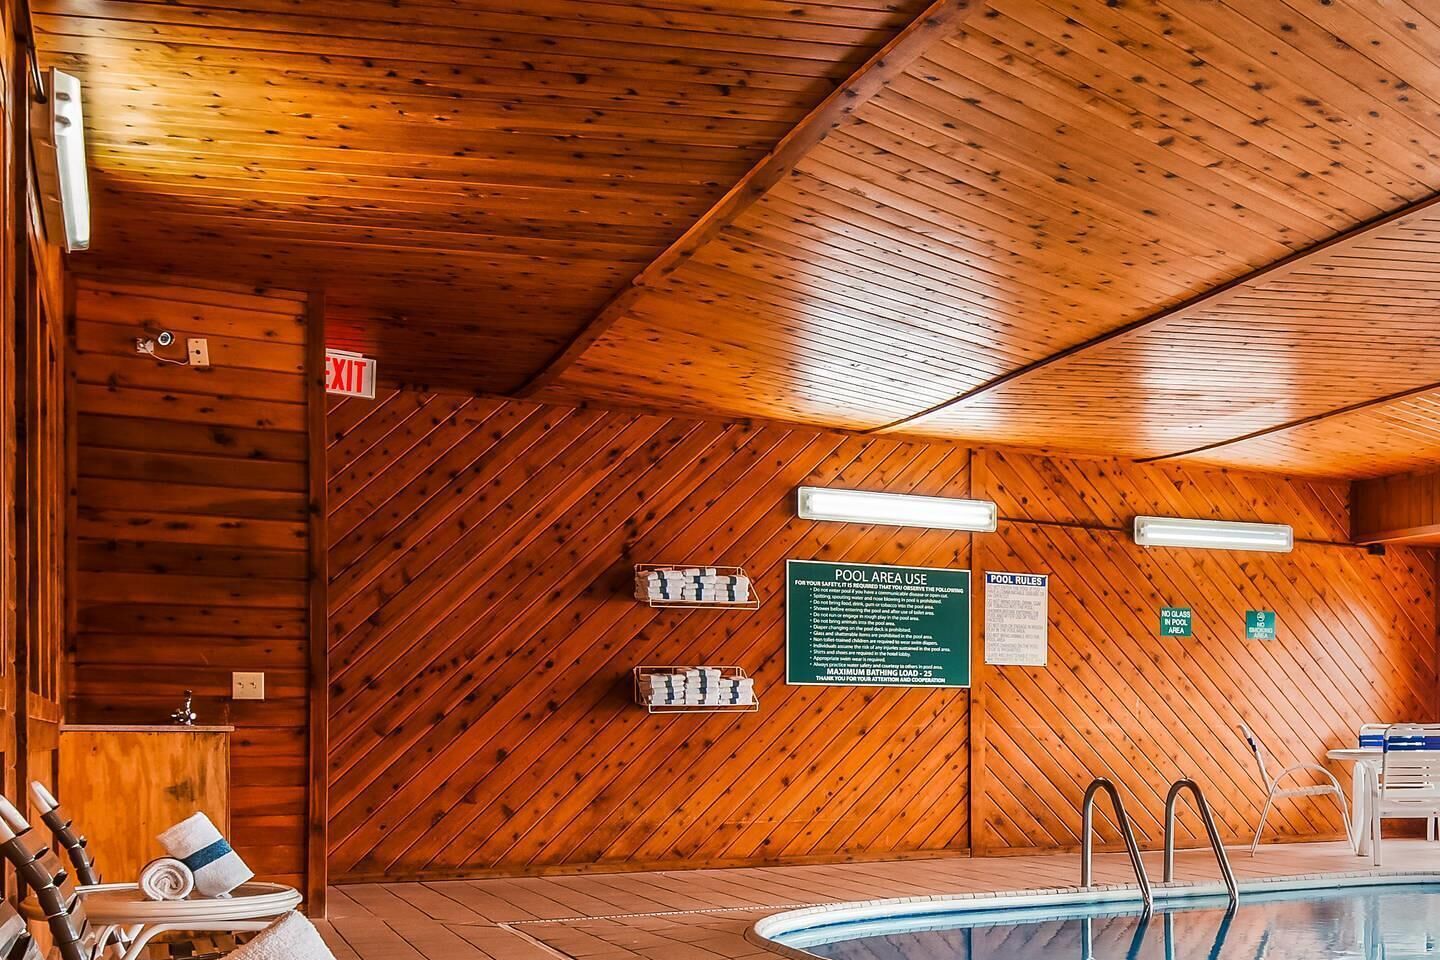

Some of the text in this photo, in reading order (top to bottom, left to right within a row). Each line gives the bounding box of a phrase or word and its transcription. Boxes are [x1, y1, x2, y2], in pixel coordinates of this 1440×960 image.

[836, 569, 927, 585] POOL AREA USE
[991, 575, 1042, 586] POOL RULES
